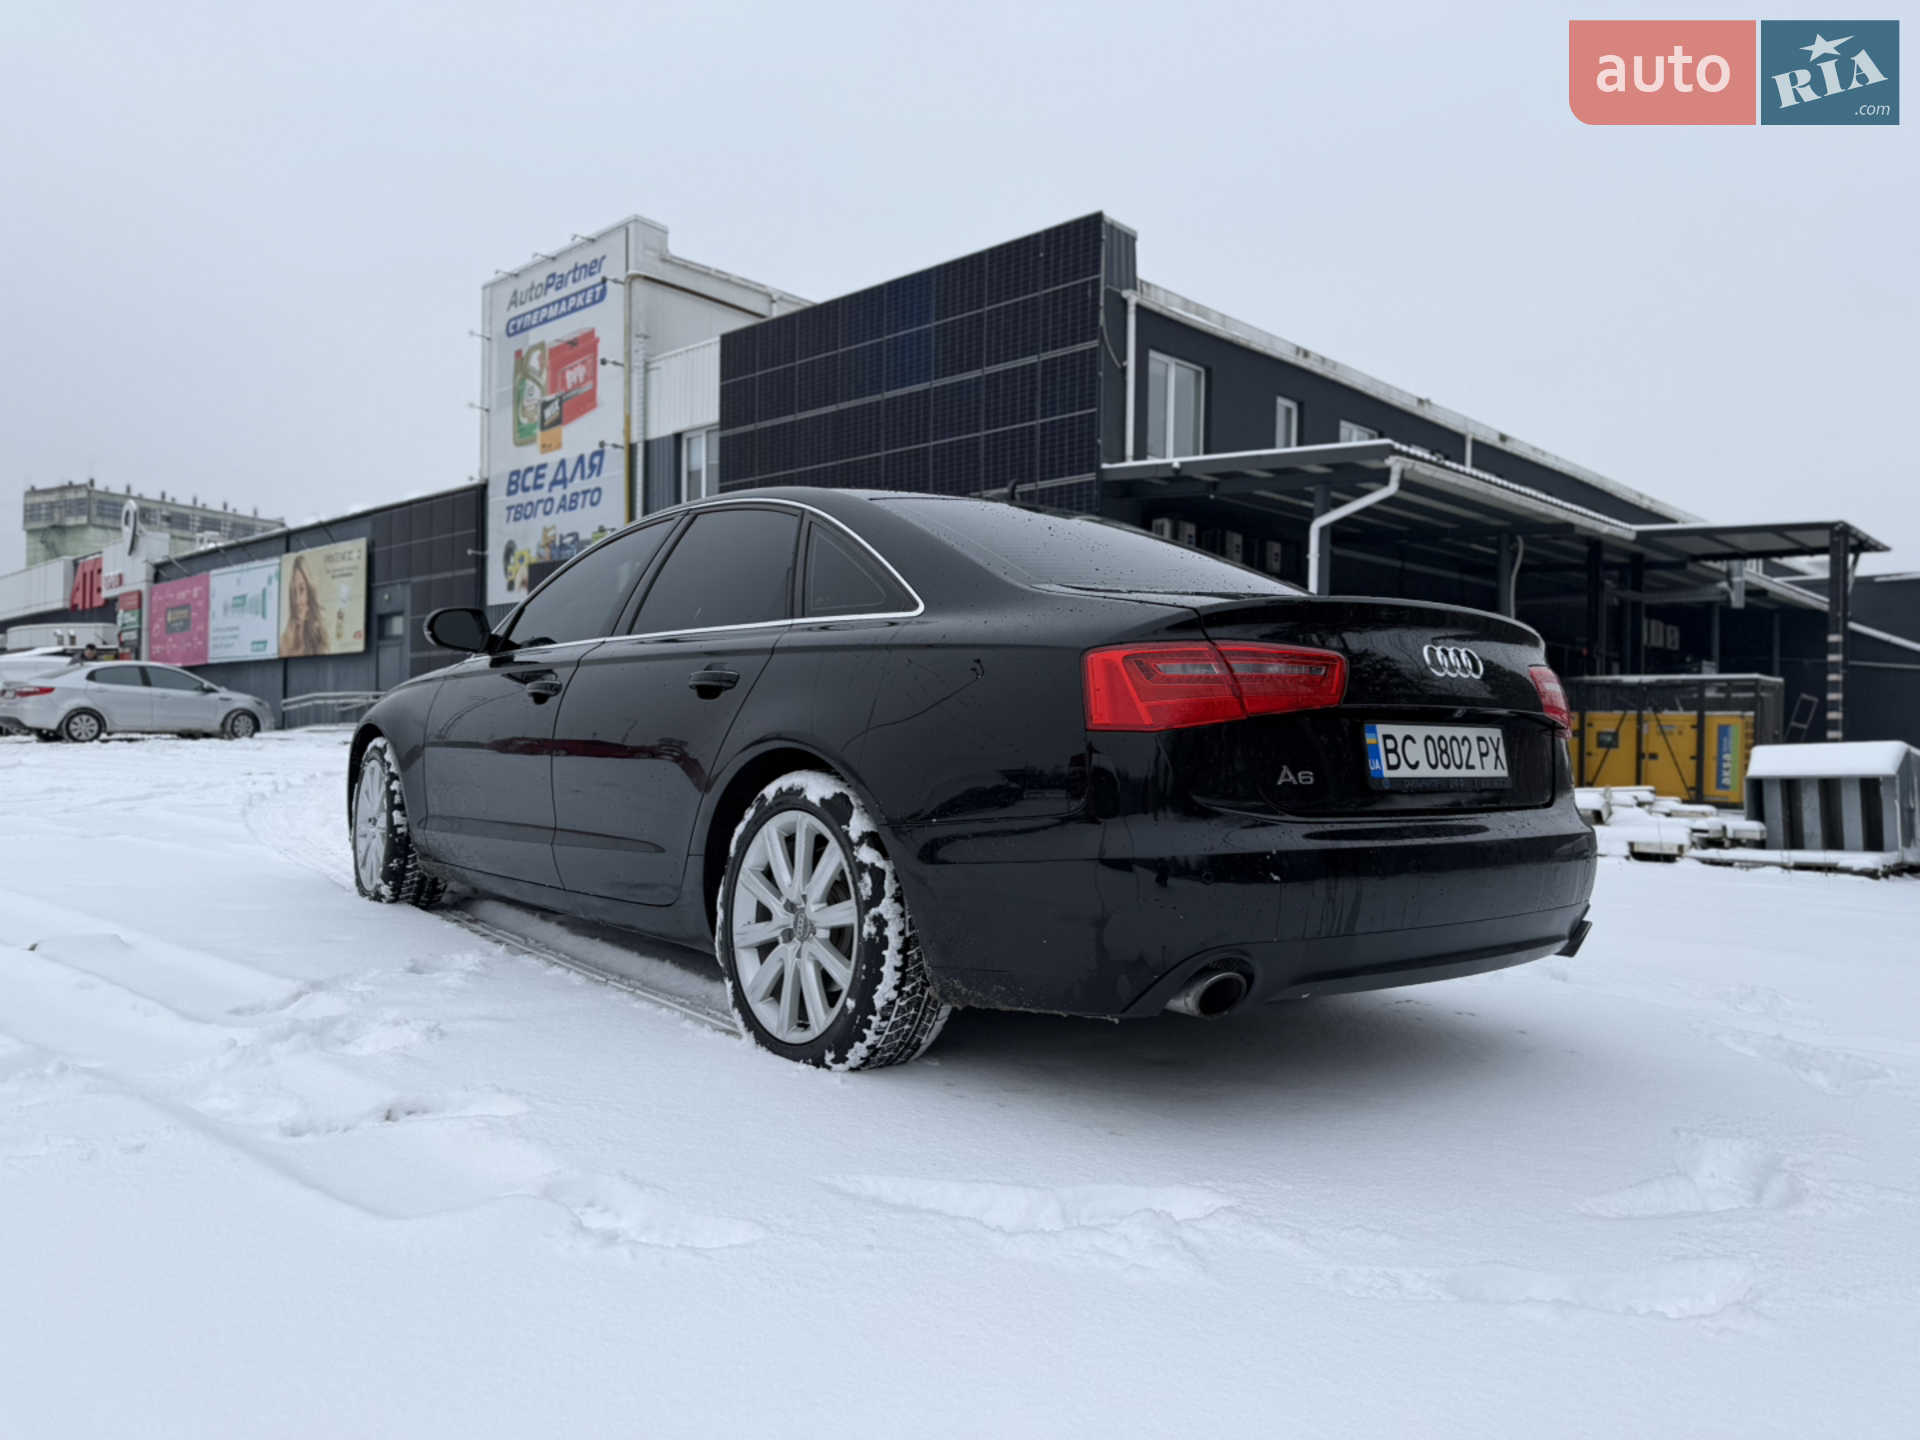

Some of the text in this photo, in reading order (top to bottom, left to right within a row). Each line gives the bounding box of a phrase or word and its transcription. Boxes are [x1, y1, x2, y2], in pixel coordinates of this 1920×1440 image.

[507, 254, 607, 311] AutoPartner
[508, 285, 603, 334] СУПЕРМАРКЕТ
[506, 450, 605, 496] ВСЕ ДЛЯ
[506, 487, 602, 523] ТВОГО АВТО
[1369, 759, 1382, 770] UA
[1382, 734, 1420, 770] BC
[1424, 735, 1476, 770] 0802
[1277, 765, 1316, 785] A6
